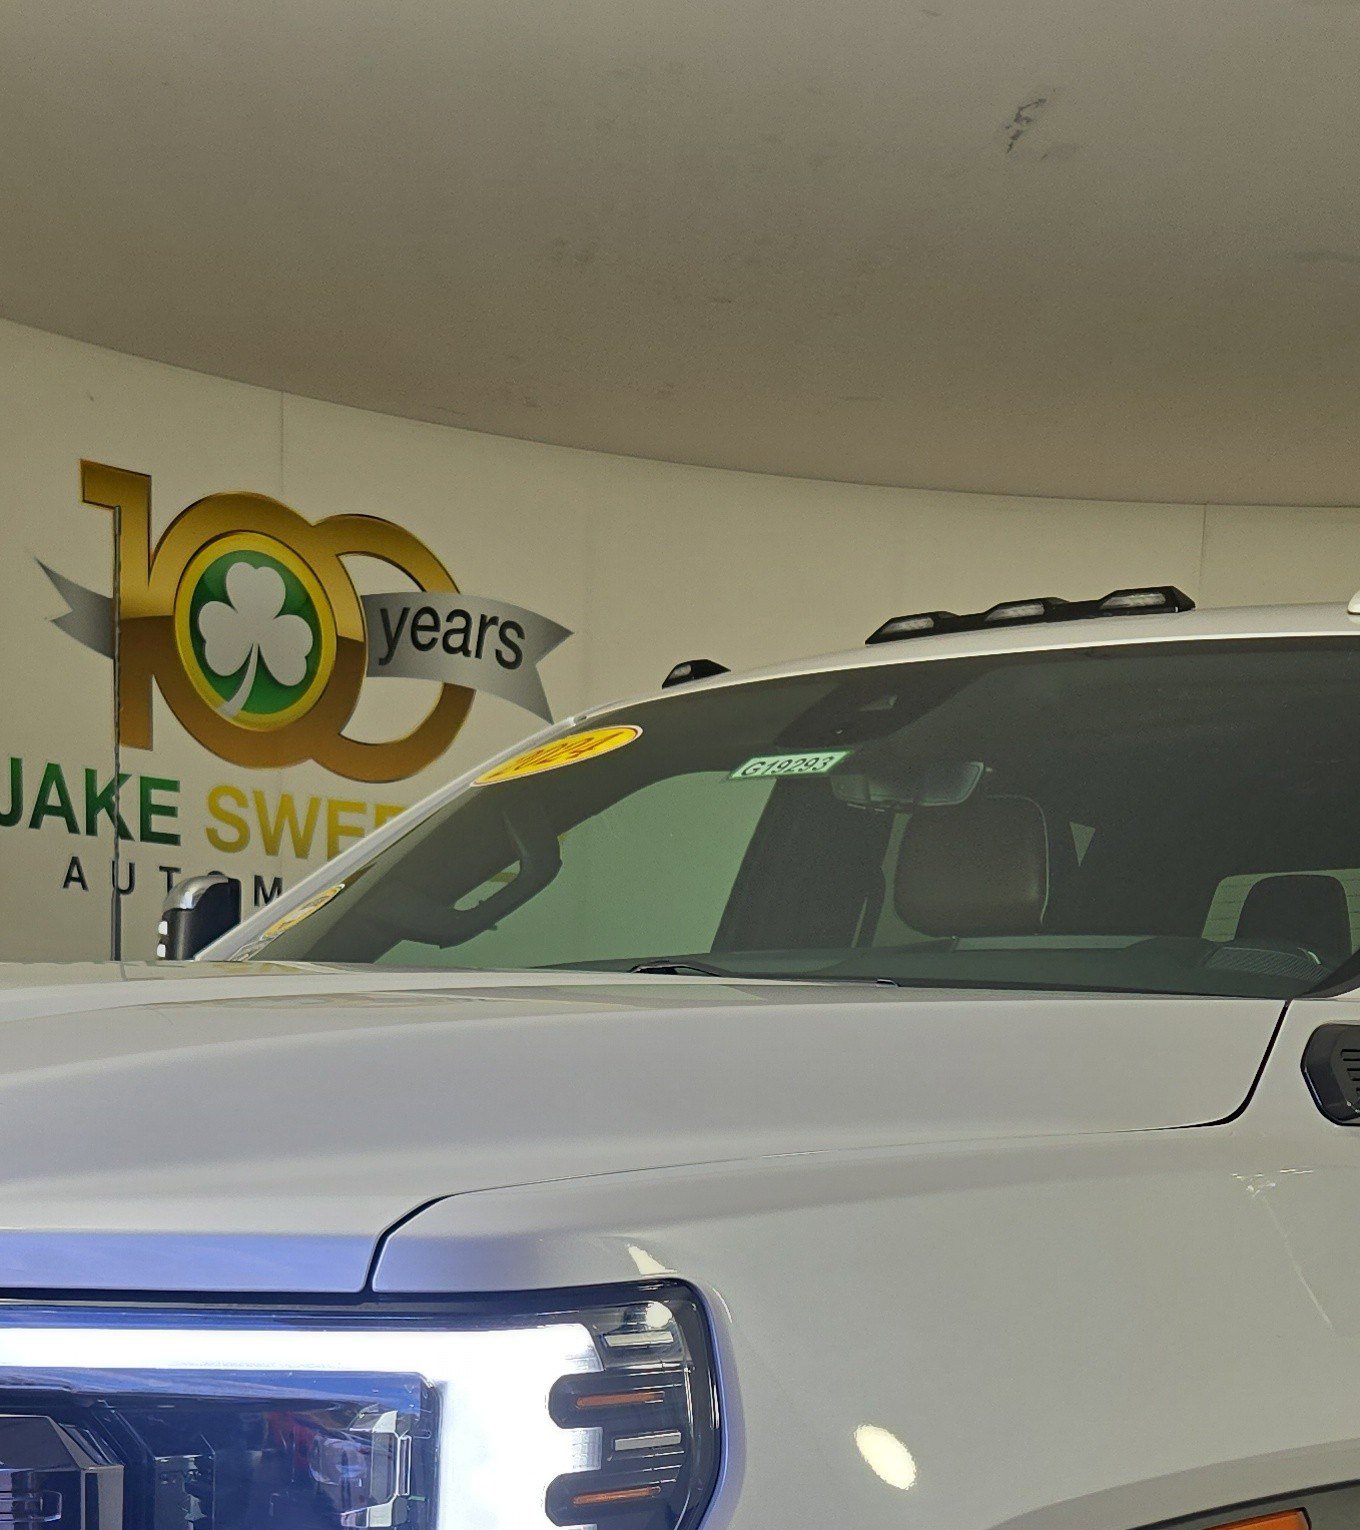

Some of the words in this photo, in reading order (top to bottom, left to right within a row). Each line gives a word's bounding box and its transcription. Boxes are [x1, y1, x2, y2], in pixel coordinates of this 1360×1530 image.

[80, 459, 477, 783] 100
[378, 603, 526, 670] years
[741, 755, 835, 777] G19293
[62, 856, 283, 907] AUTM
